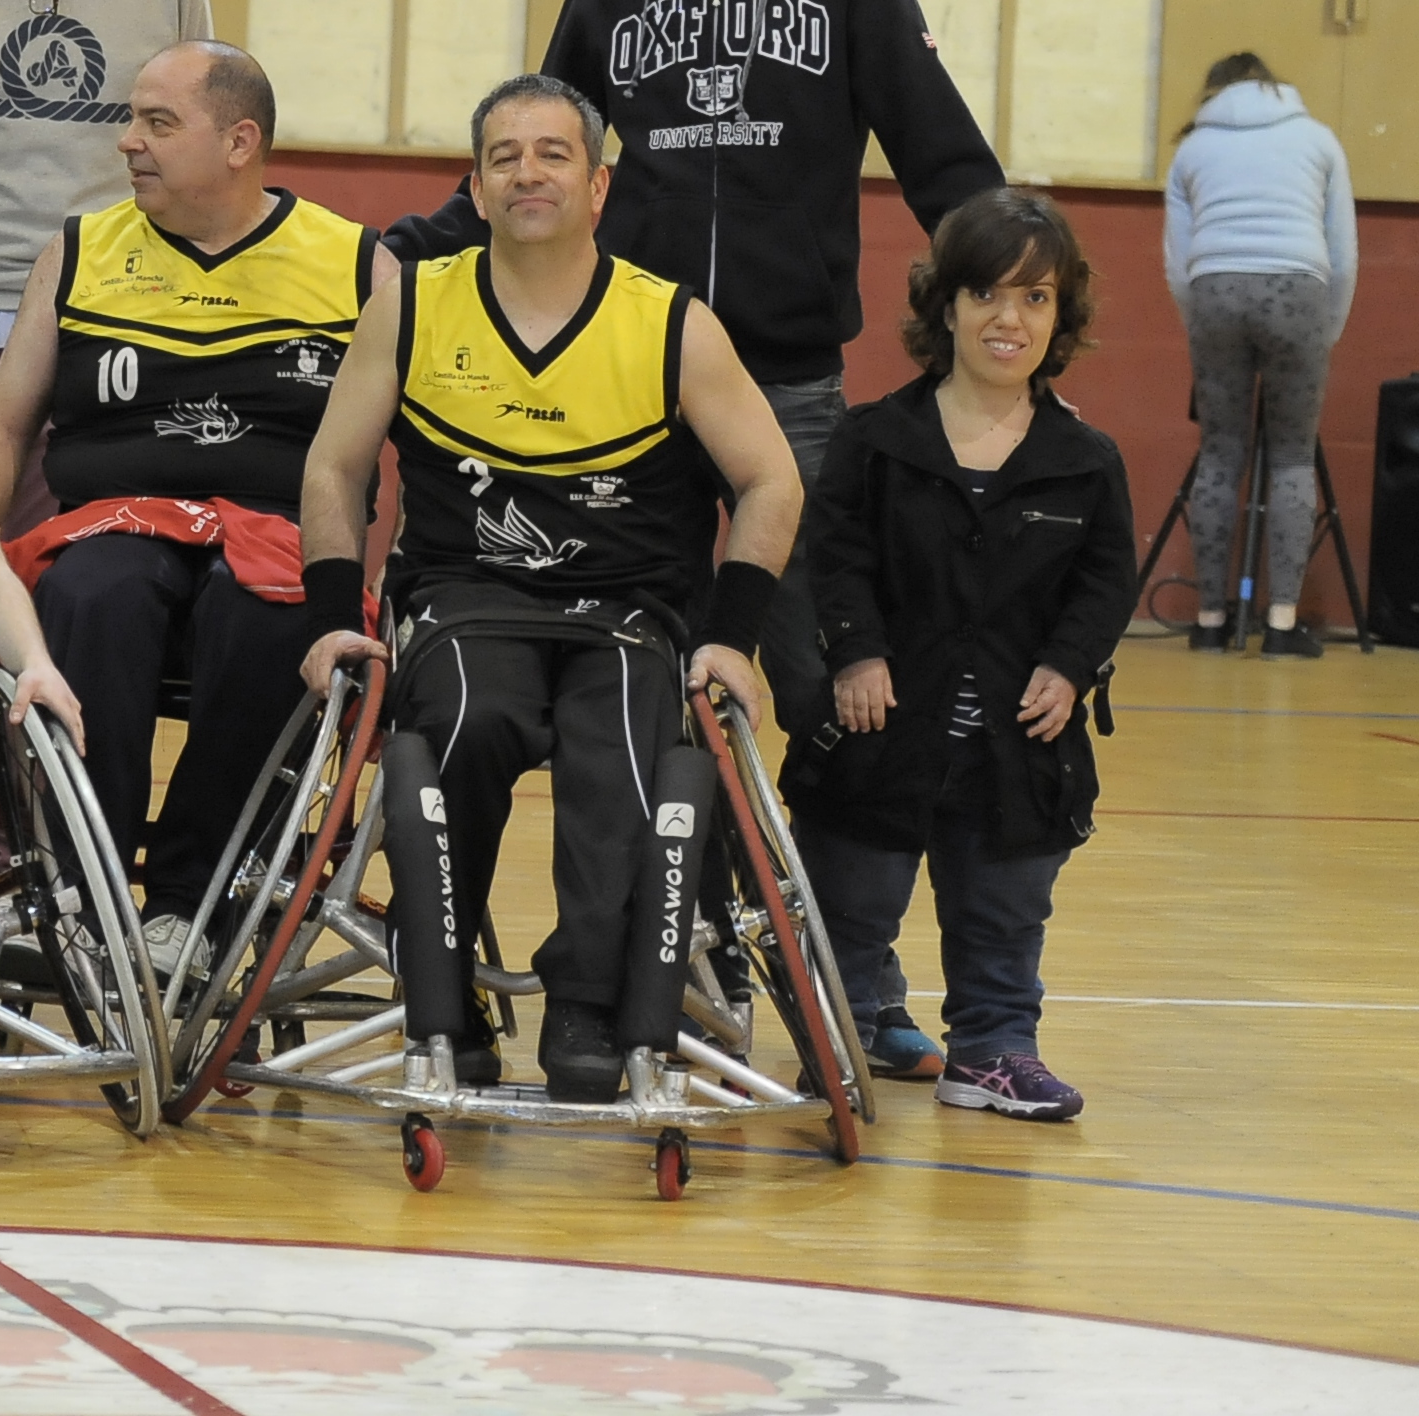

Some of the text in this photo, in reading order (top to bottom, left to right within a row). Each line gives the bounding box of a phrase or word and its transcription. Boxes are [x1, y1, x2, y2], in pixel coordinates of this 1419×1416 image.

[648, 121, 784, 150] UNIVERSITY
[200, 295, 240, 308] rasán
[97, 346, 139, 403] 10
[525, 406, 566, 423] rasán
[436, 832, 458, 950] DOMYOS
[659, 845, 685, 964] DOMYOS
